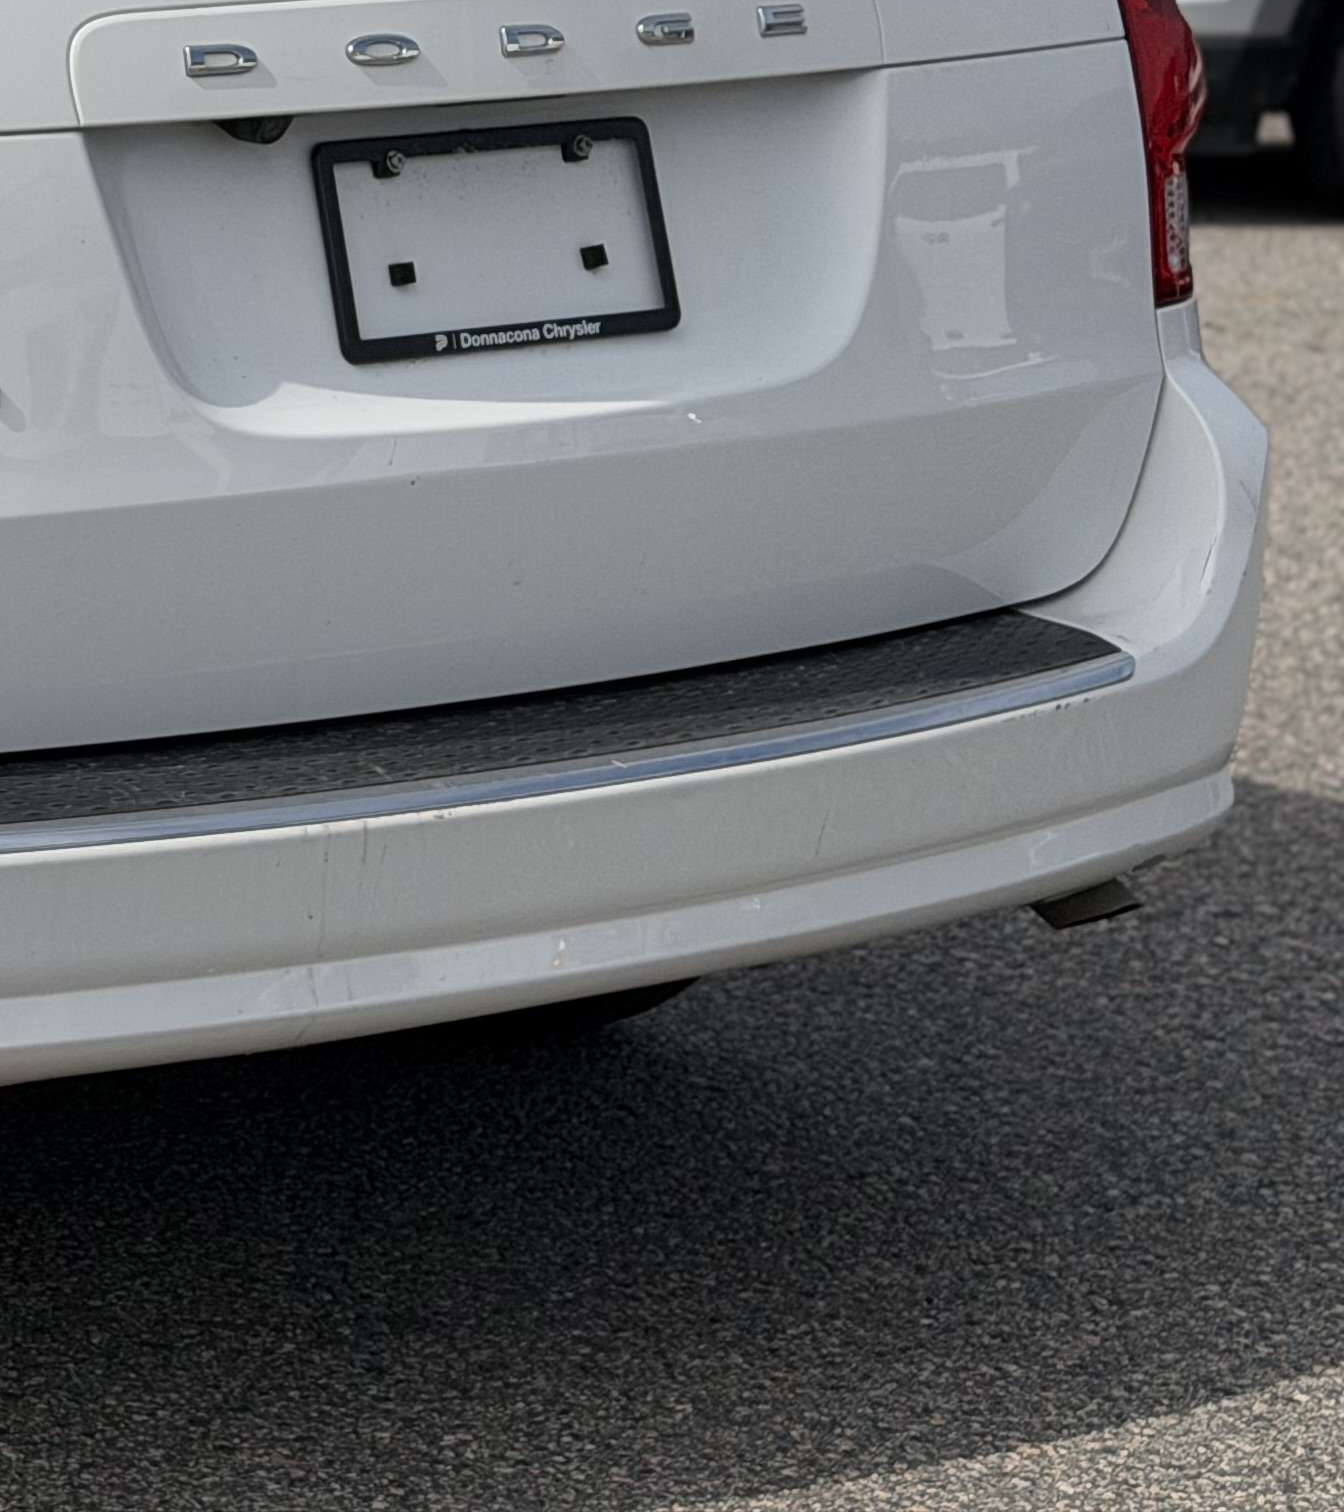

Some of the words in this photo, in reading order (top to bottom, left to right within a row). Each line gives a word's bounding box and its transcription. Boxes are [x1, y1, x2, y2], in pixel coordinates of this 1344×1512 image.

[184, 3, 808, 77] DODGE
[460, 327, 540, 348] Donnacona
[542, 320, 601, 340] Chrysler
